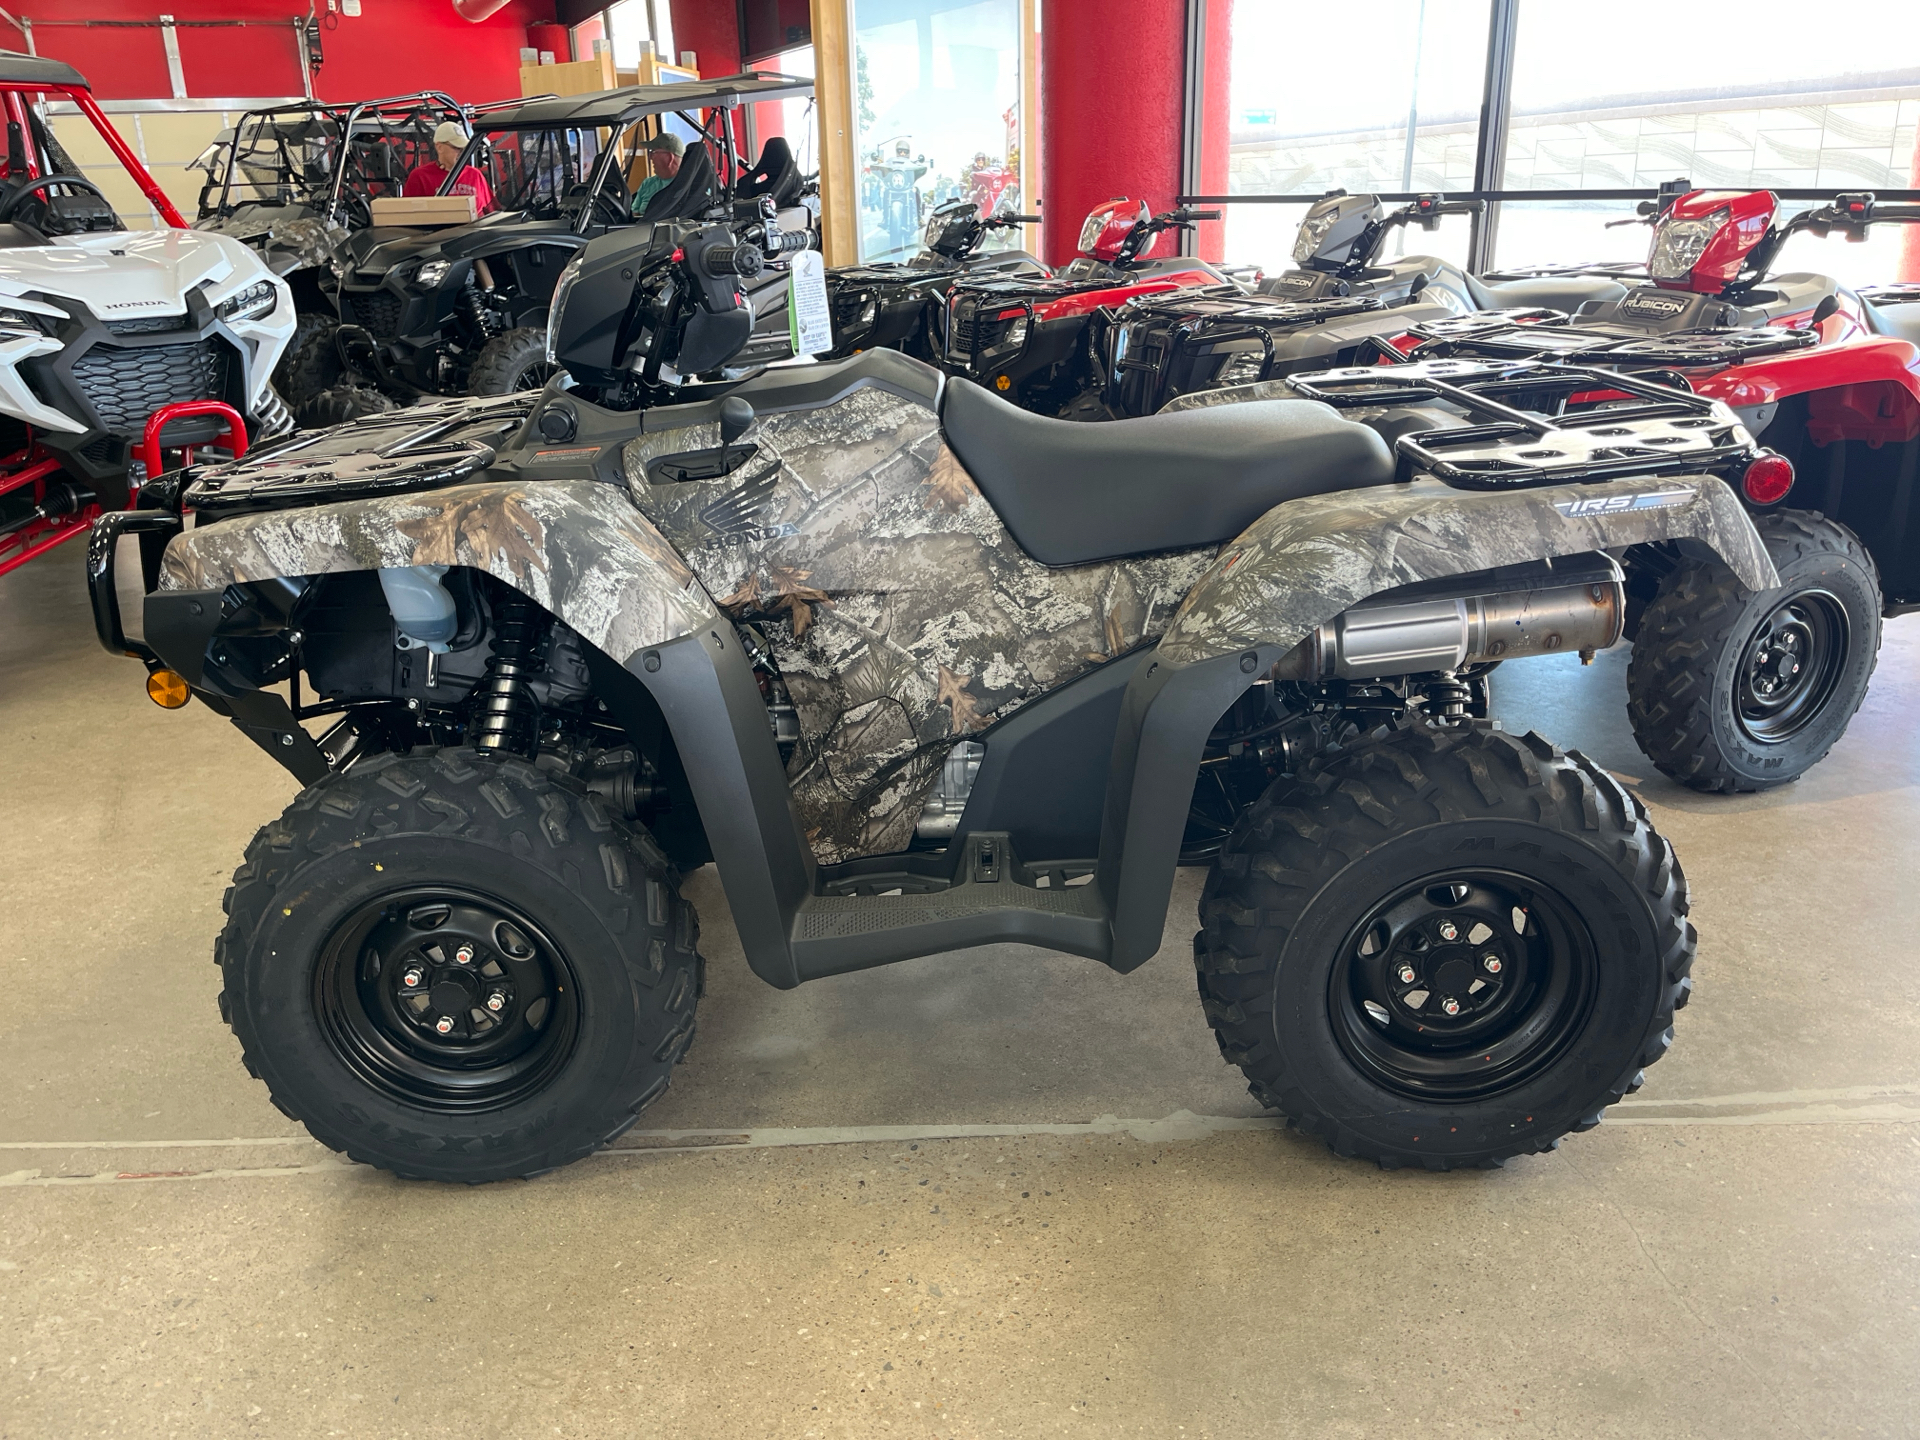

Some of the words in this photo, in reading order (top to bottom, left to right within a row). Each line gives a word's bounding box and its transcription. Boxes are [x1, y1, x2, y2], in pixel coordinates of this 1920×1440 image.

[104, 300, 170, 310] HONDA
[1623, 298, 1685, 314] RUBICON
[1569, 495, 1634, 513] IRS
[704, 523, 801, 551] HONDA
[332, 1101, 558, 1154] MAXXIS
